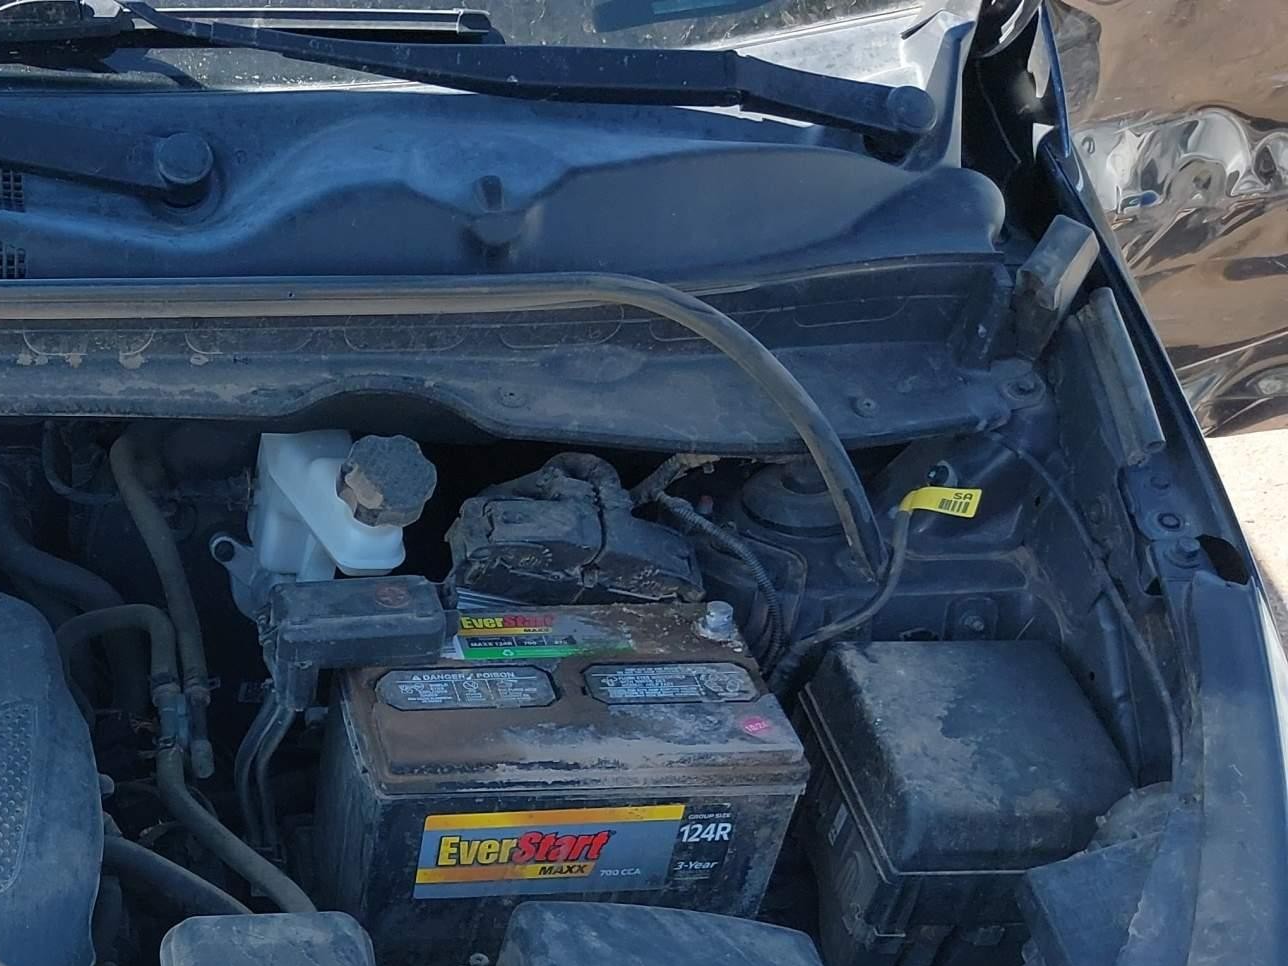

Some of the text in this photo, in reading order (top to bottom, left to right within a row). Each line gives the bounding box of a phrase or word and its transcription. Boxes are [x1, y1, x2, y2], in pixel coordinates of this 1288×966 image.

[954, 492, 973, 500] SA
[460, 614, 554, 629] EverStart
[422, 673, 465, 681] DANGER
[476, 671, 515, 680] POISON
[679, 822, 732, 843] 124R
[436, 829, 611, 866] EverStart
[538, 863, 588, 876] MAXX
[674, 860, 719, 871] 3-Year
[599, 867, 641, 877] 700 CCA
